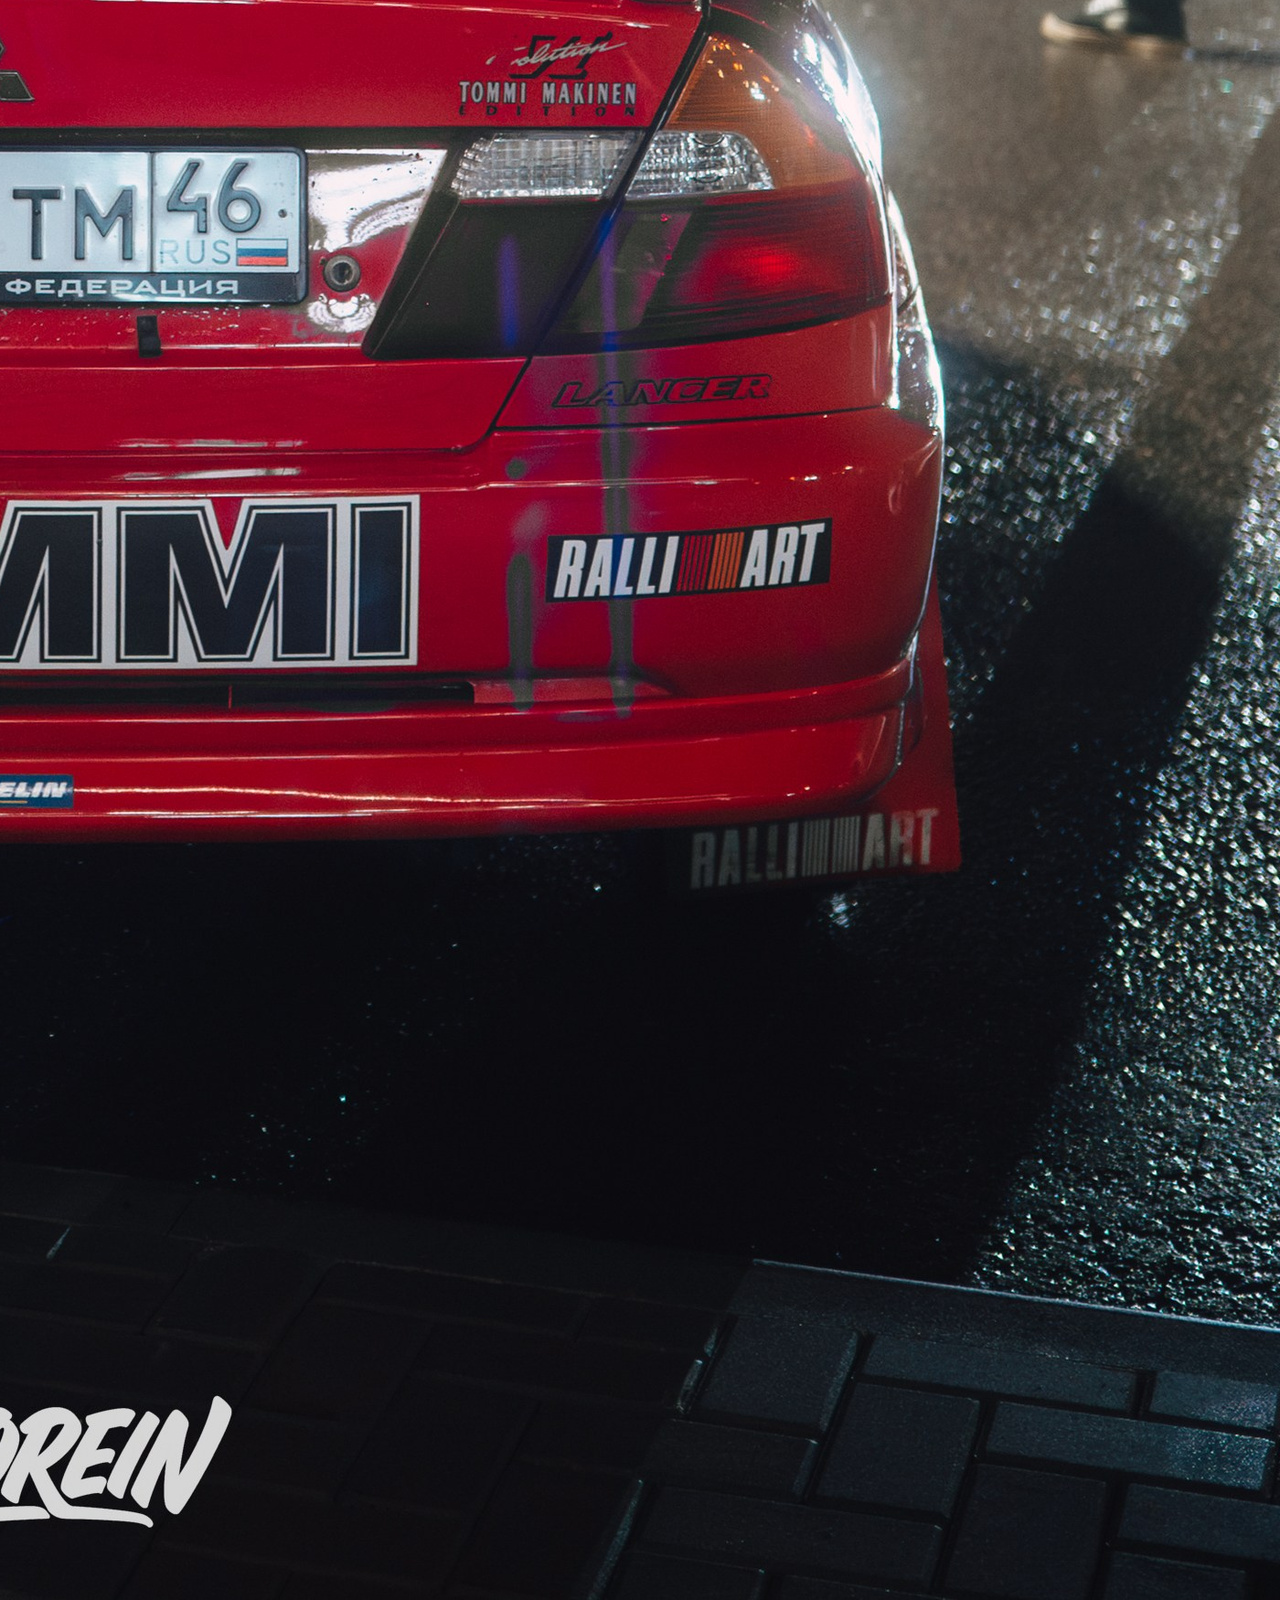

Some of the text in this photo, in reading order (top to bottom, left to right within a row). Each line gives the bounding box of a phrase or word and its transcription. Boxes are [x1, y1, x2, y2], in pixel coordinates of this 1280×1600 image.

[458, 80, 637, 105] TOMMI MAKINEN
[458, 103, 636, 117] EDITION
[166, 157, 262, 234] 46
[158, 237, 232, 266] RUS
[4, 277, 240, 298] ФЕДЕРАЦИЯ
[551, 374, 772, 408] LANCER
[553, 522, 826, 598] RALLI ART
[689, 807, 940, 889] RALLI ART
